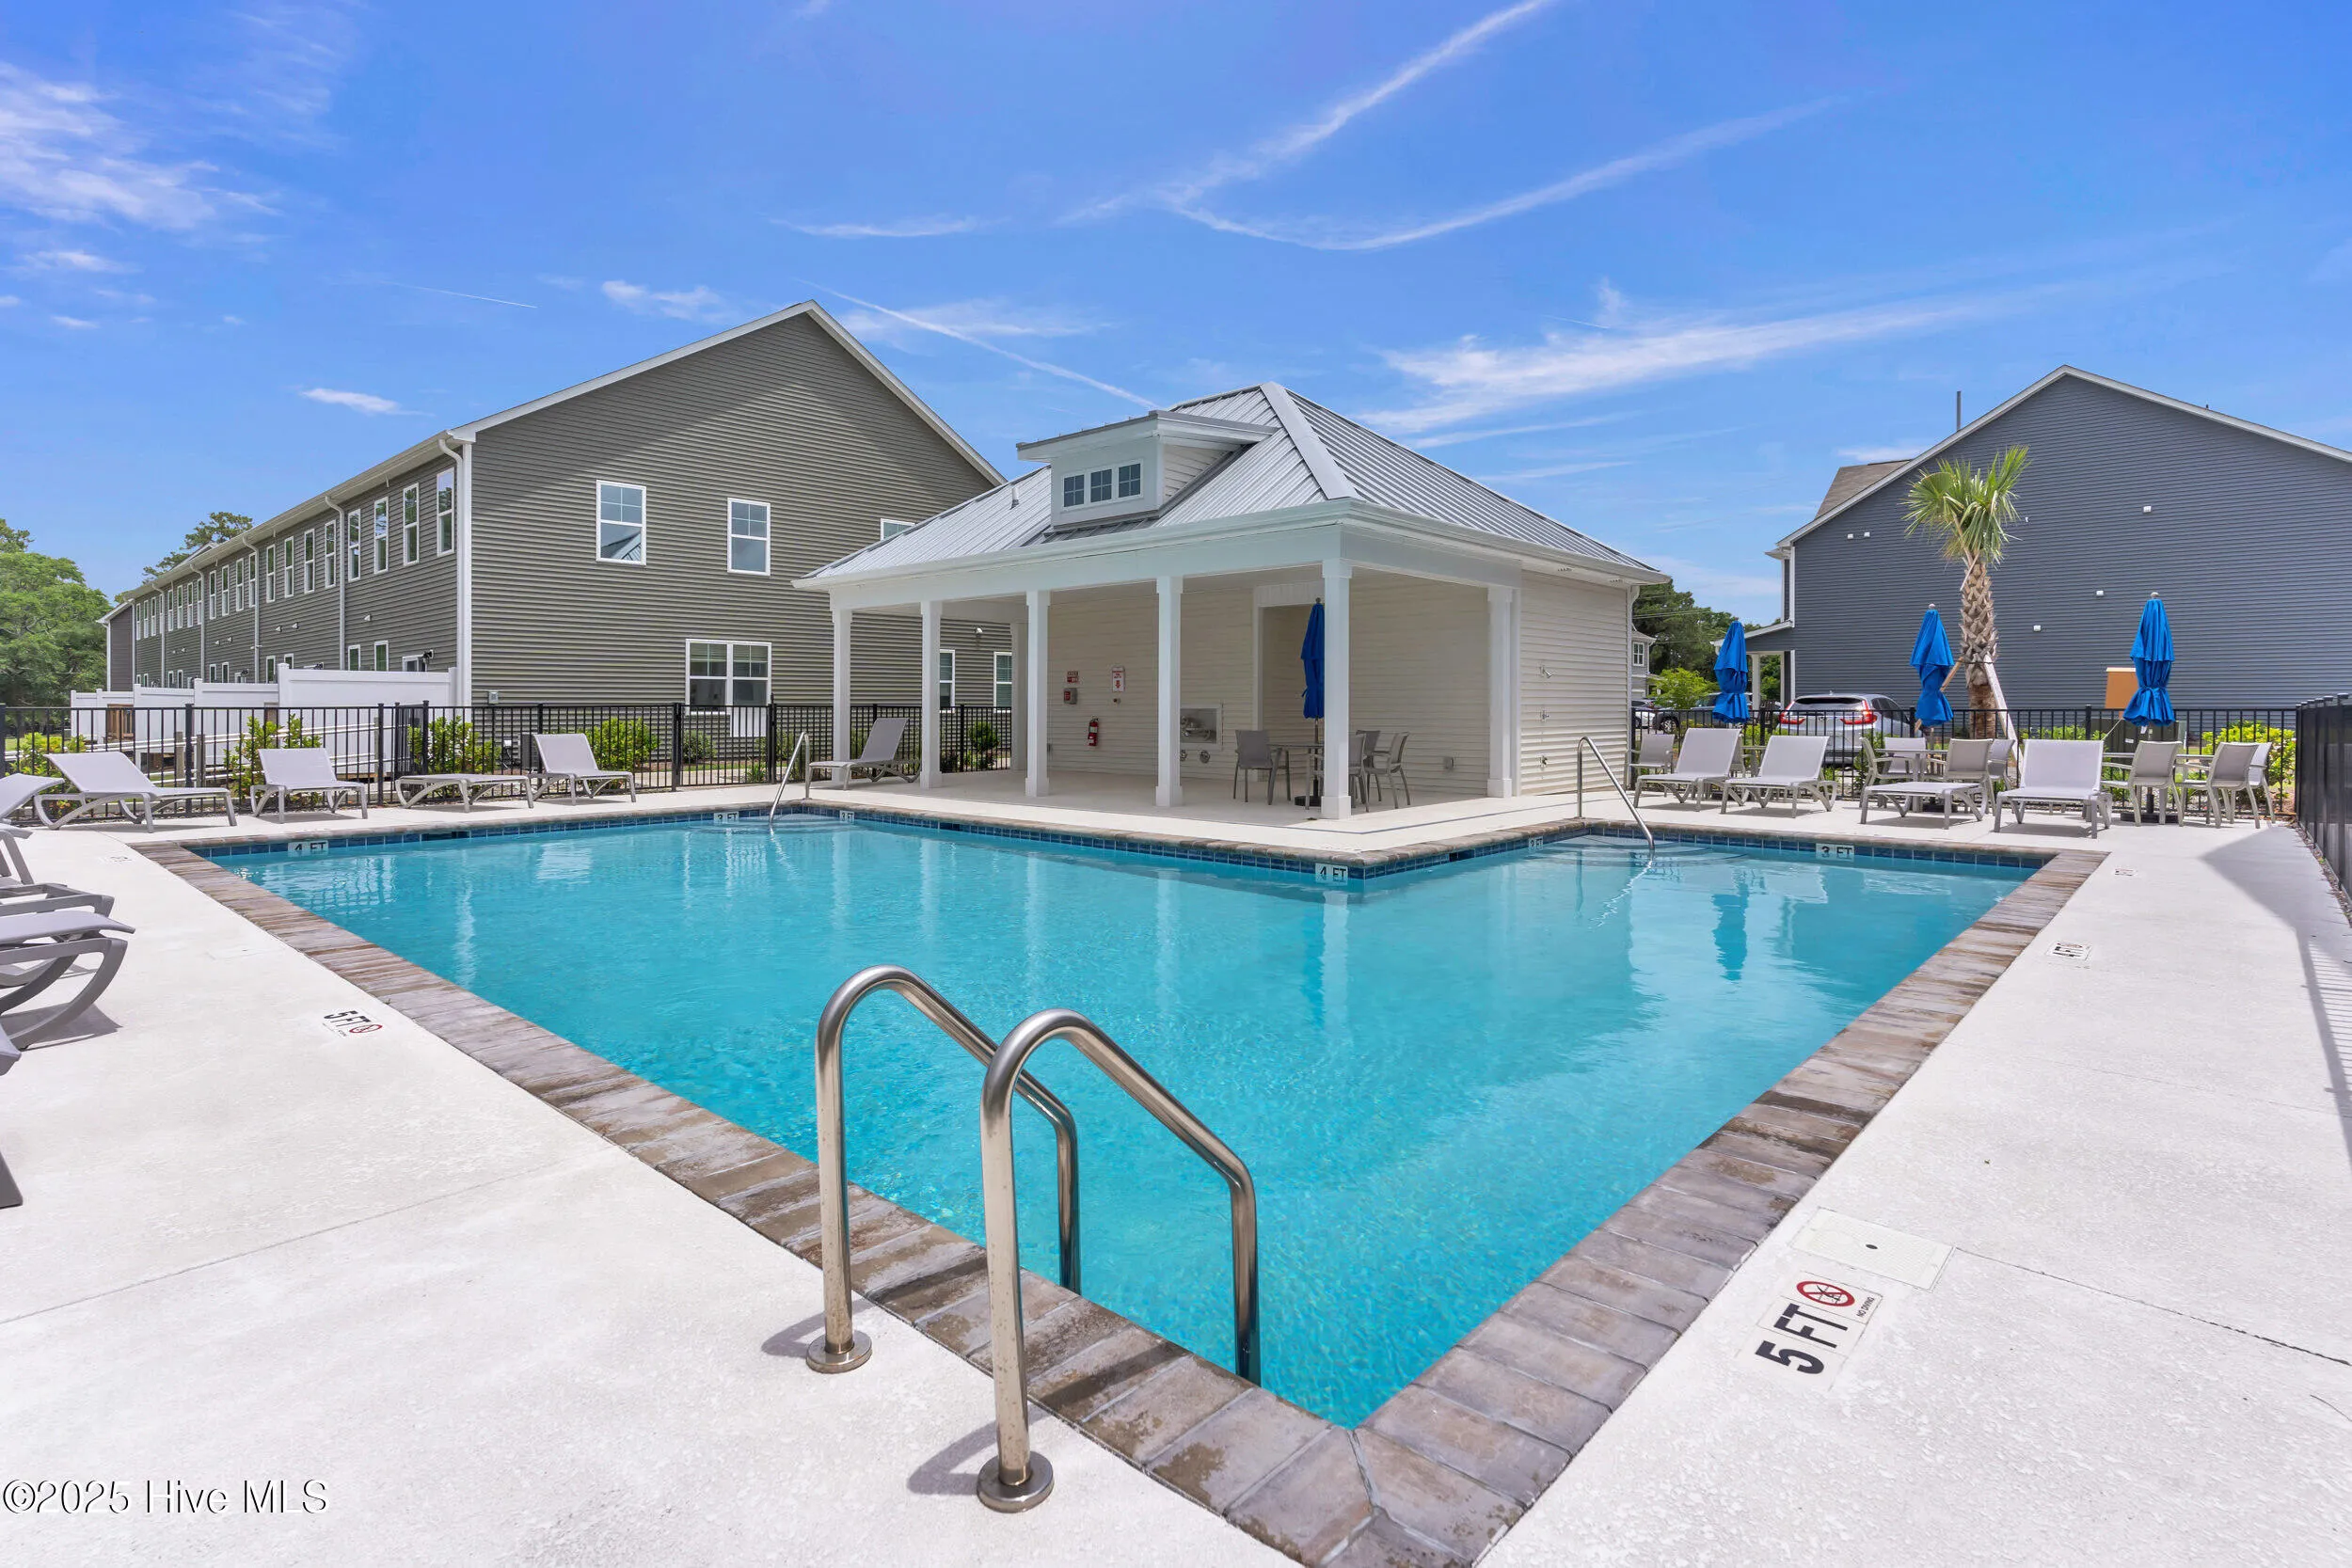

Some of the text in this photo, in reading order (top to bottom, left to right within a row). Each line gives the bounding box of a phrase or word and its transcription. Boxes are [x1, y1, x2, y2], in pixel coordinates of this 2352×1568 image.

[1332, 867, 1347, 877] FT
[324, 1010, 372, 1028] 5 FT
[1755, 1303, 1849, 1375] 5 FT
